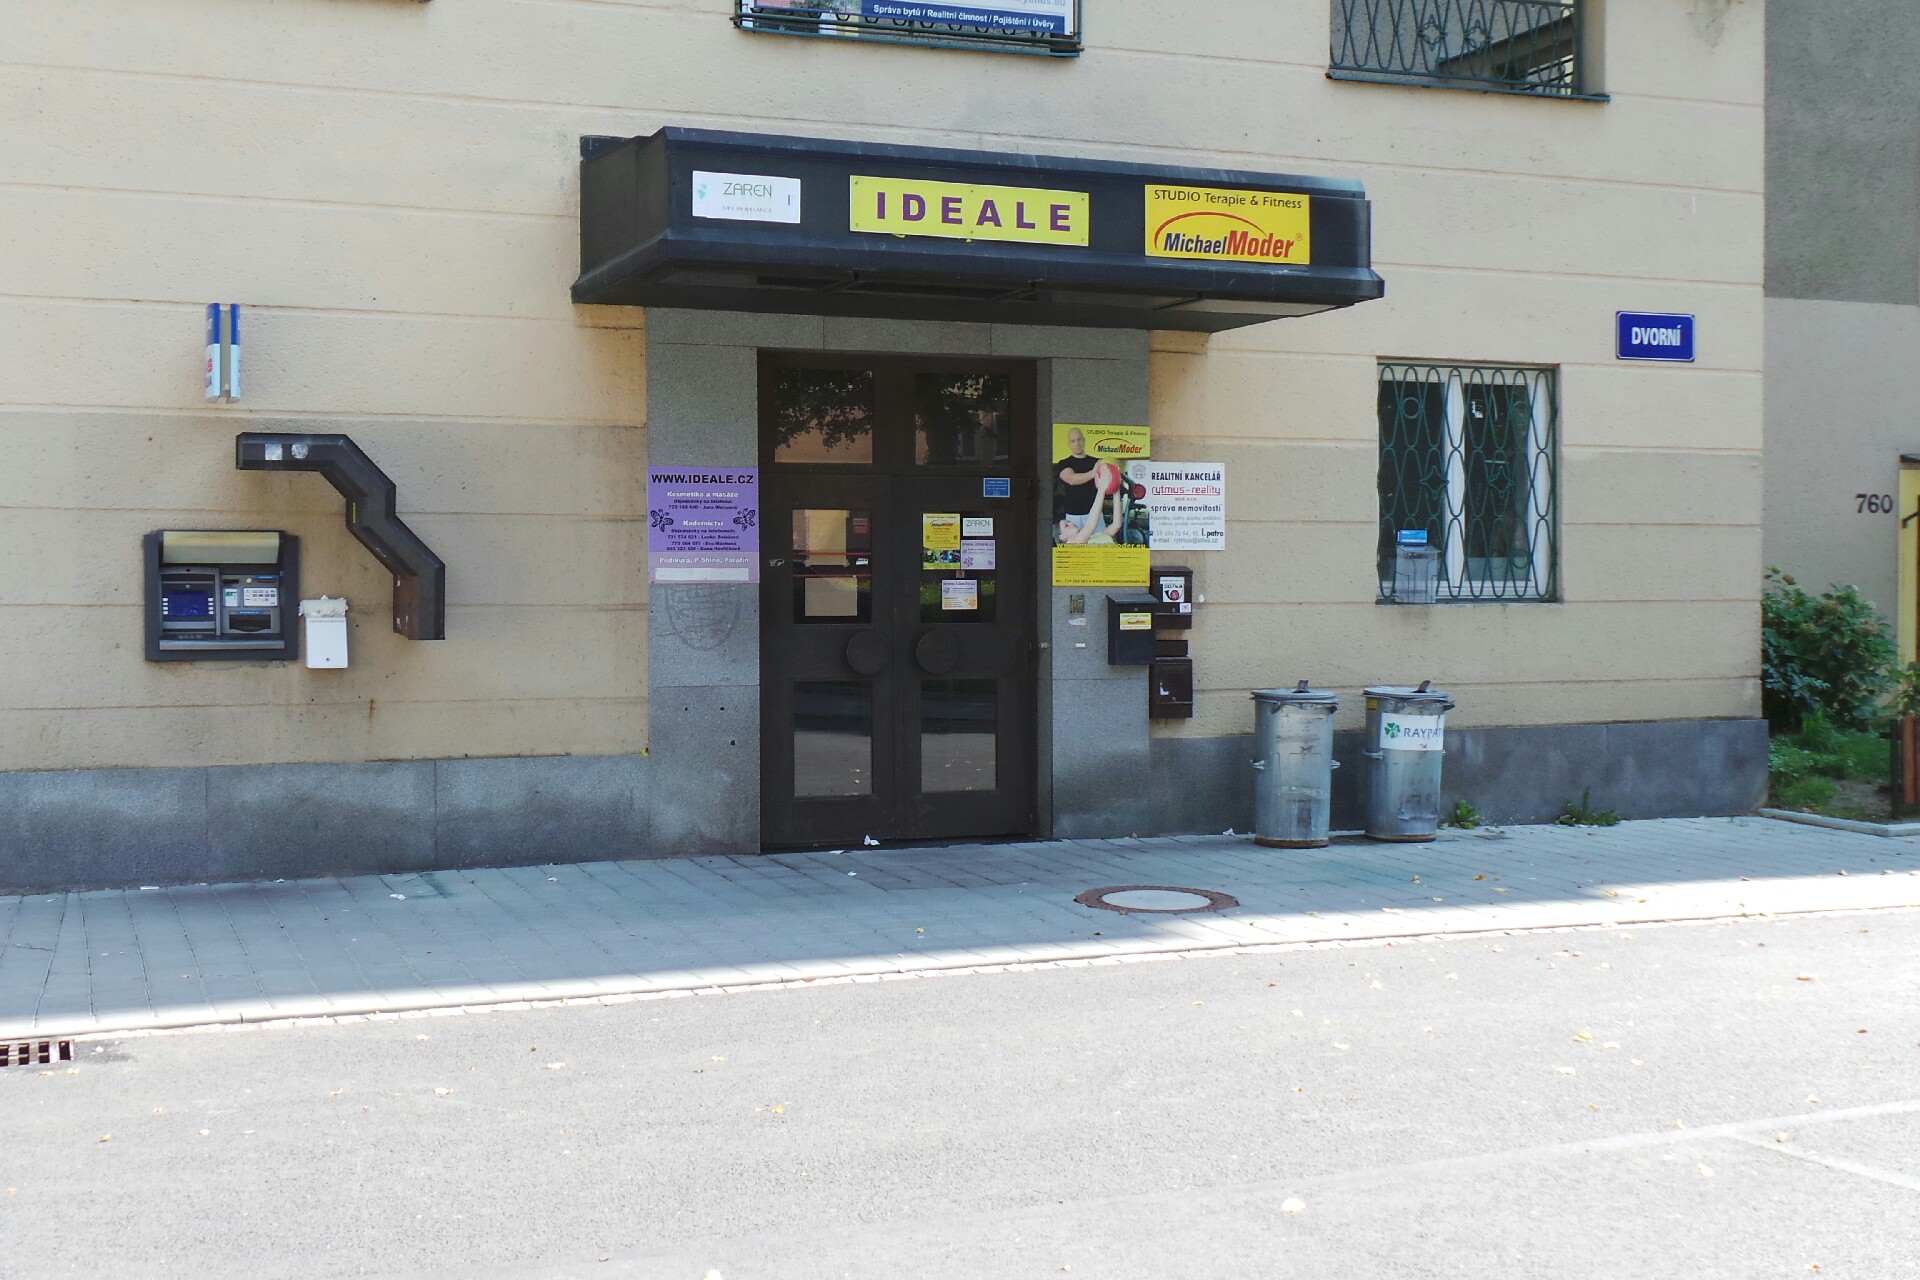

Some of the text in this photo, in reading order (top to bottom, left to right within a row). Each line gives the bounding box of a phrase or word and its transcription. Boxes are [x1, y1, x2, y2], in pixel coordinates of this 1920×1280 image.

[873, 4, 901, 15] Správa
[903, 7, 920, 17] bytů
[927, 9, 957, 19] Realitní
[958, 13, 988, 22] činnost
[993, 15, 1027, 26] Pojištění
[1032, 17, 1055, 30] Úvěry
[723, 182, 772, 197] ZAREN
[1154, 190, 1302, 209] STUDIO Terapie & Fitness
[876, 191, 1071, 232] IDEALE
[1631, 324, 1682, 346] DVORNÍ
[652, 474, 754, 484] WWW.IDEALE.CZ
[1152, 470, 1220, 481] REALITNÍ KANCELÁŘ
[1152, 485, 1184, 496] rytmus
[1192, 485, 1220, 496] reality
[1150, 504, 1223, 514] správa nemovitostí
[1855, 494, 1894, 514] 760
